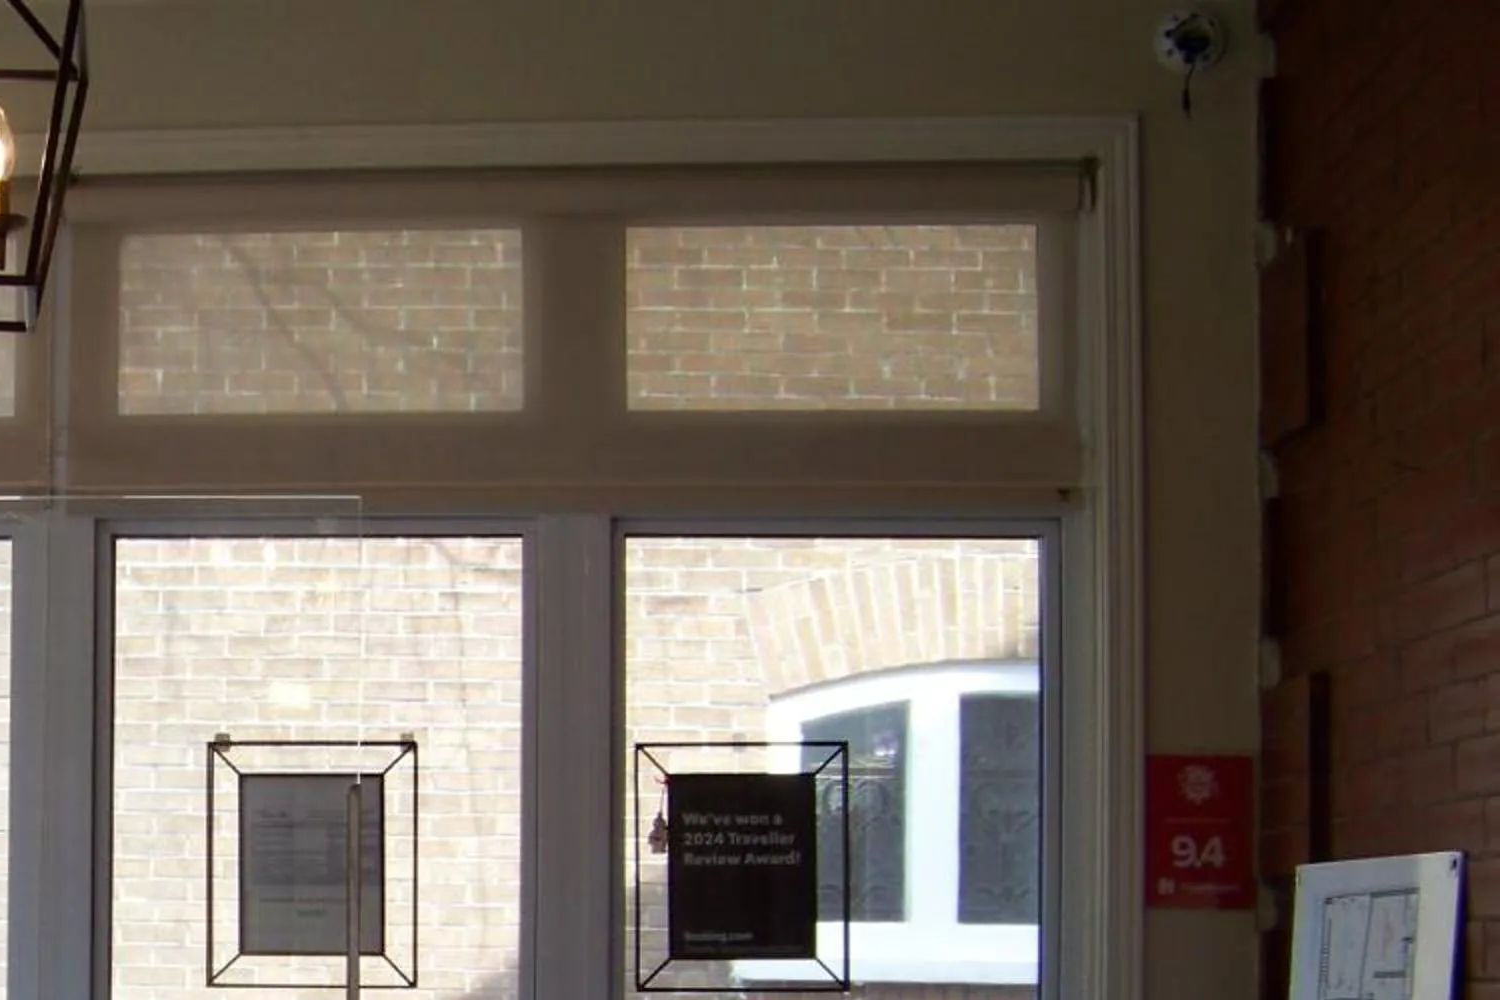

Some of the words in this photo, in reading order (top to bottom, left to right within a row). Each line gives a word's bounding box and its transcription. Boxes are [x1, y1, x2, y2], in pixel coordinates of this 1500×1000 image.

[681, 812, 731, 826] We've
[736, 814, 769, 826] won
[774, 814, 784, 826] a
[682, 833, 725, 846] 2024
[728, 832, 797, 846] Traveller
[683, 852, 741, 866] Review
[744, 852, 802, 866] Award!
